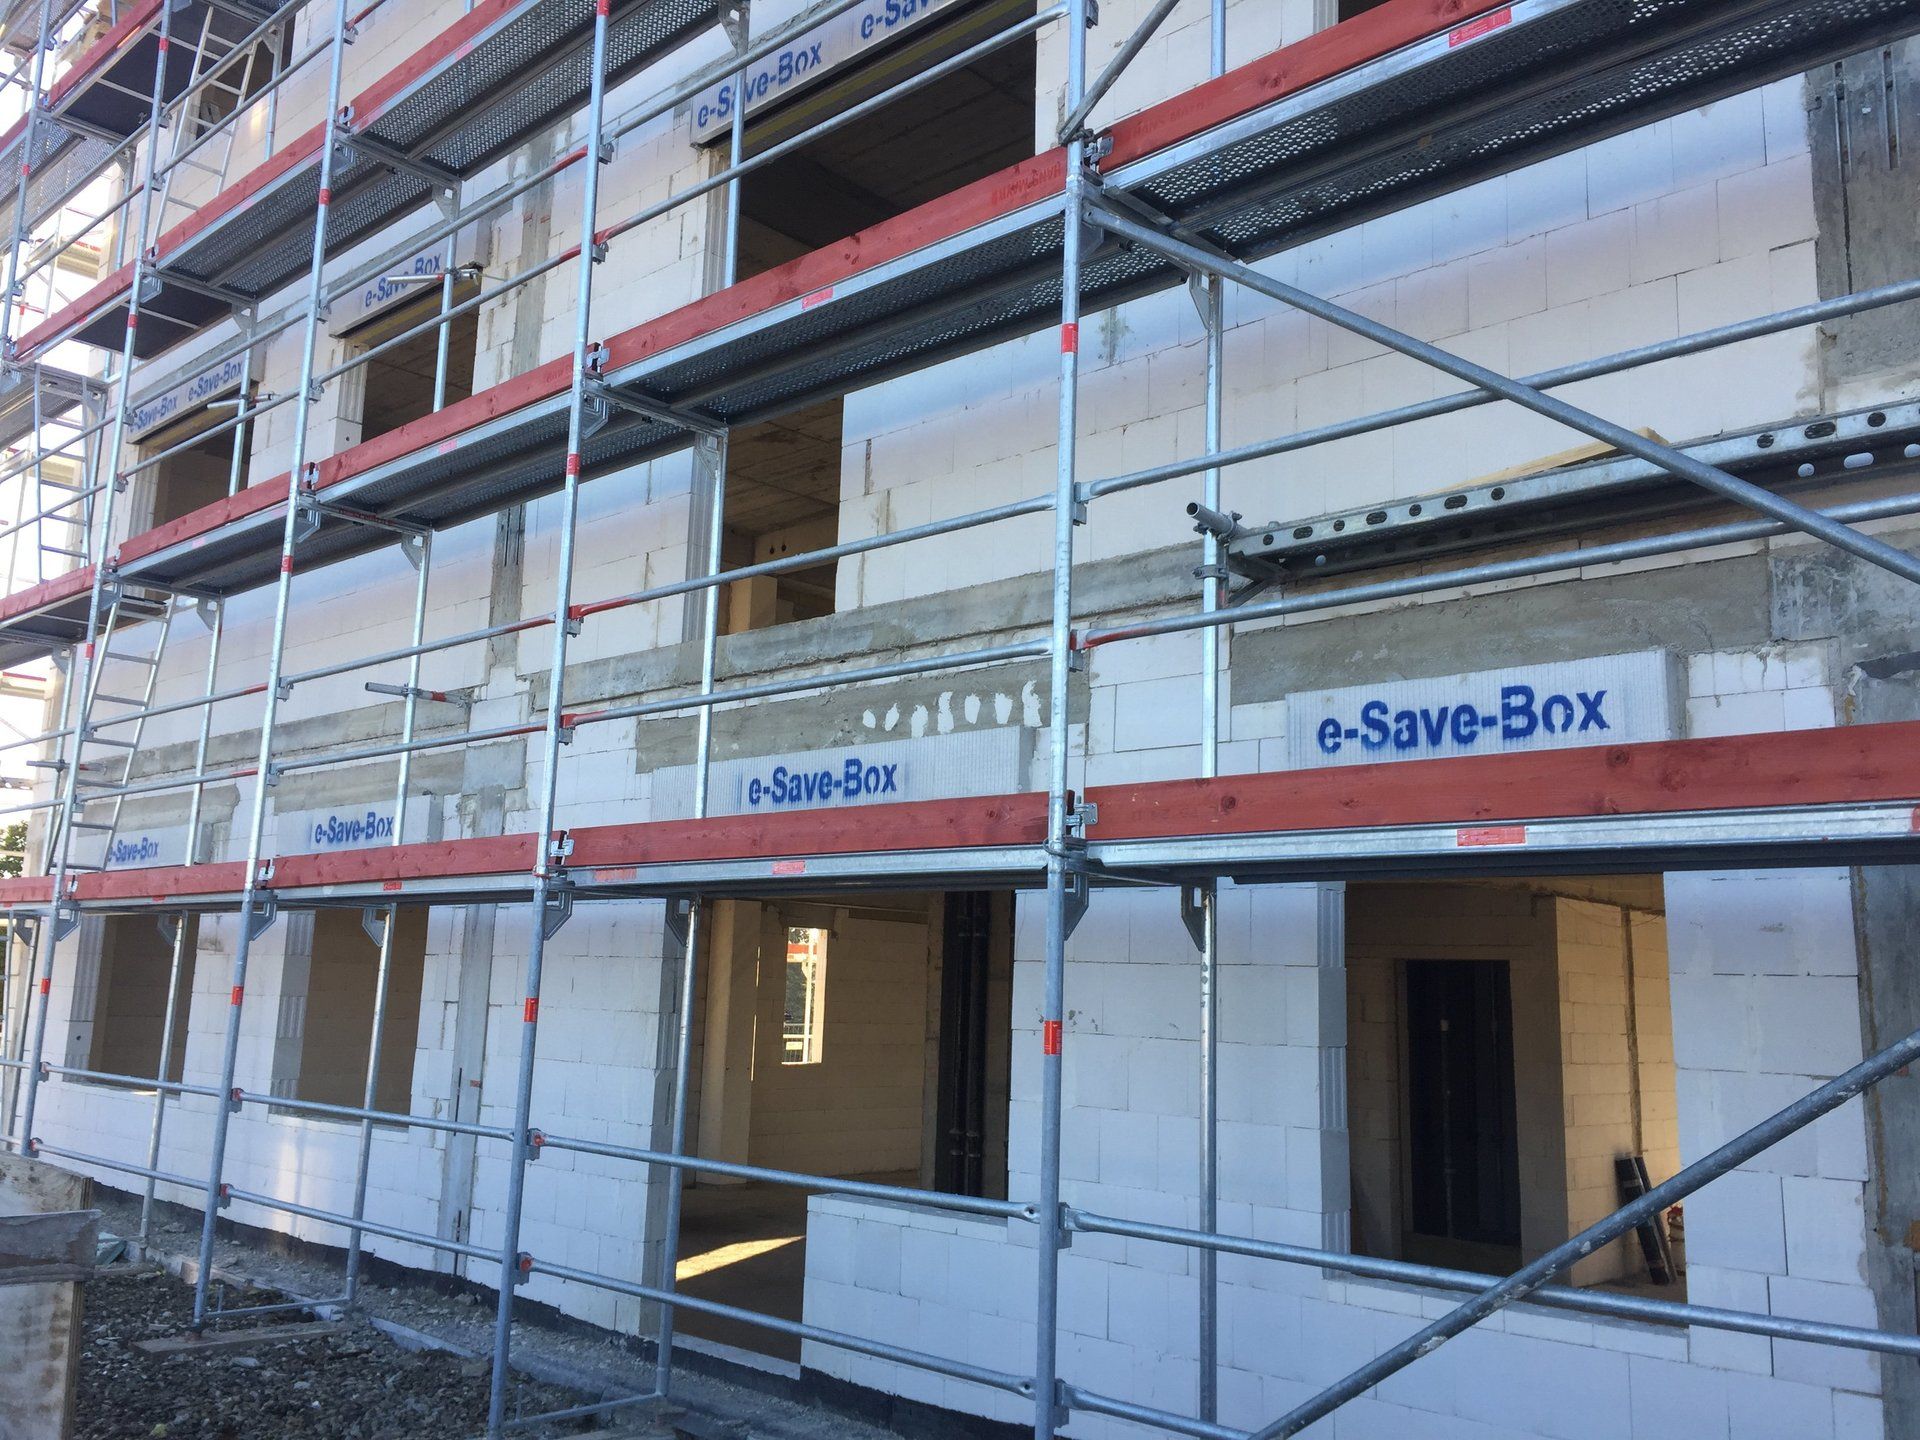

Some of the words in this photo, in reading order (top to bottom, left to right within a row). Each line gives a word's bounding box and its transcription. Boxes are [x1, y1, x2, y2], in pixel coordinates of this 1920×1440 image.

[697, 40, 822, 129] e-Sve-Box
[188, 361, 242, 402] e-Save-Box
[1317, 684, 1611, 754] e-Save-Box
[748, 757, 898, 806] e-Save-Box
[314, 811, 394, 844] e-Save-Box
